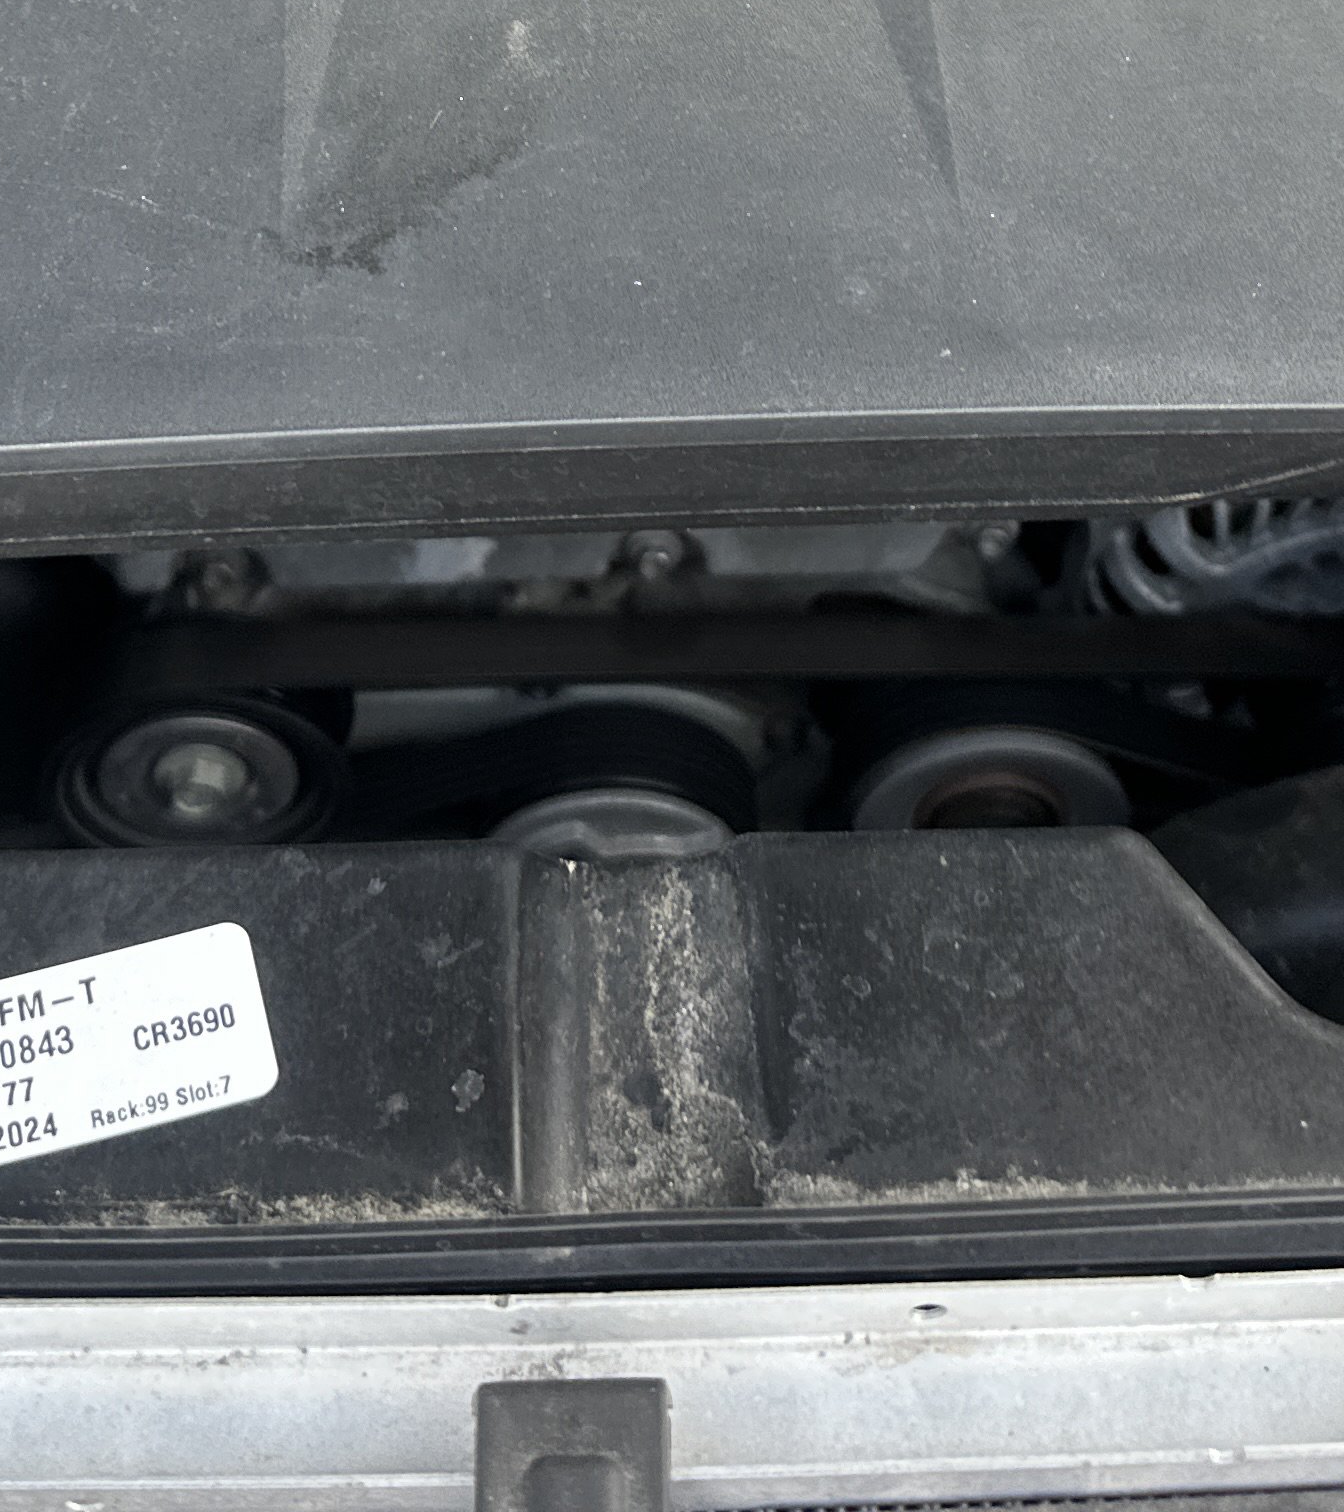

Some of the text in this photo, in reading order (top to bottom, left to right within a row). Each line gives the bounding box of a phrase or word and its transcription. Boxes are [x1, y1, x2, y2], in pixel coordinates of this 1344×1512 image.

[132, 1002, 236, 1052] CR3690
[90, 1074, 231, 1129] Rack:99 Slot:7
